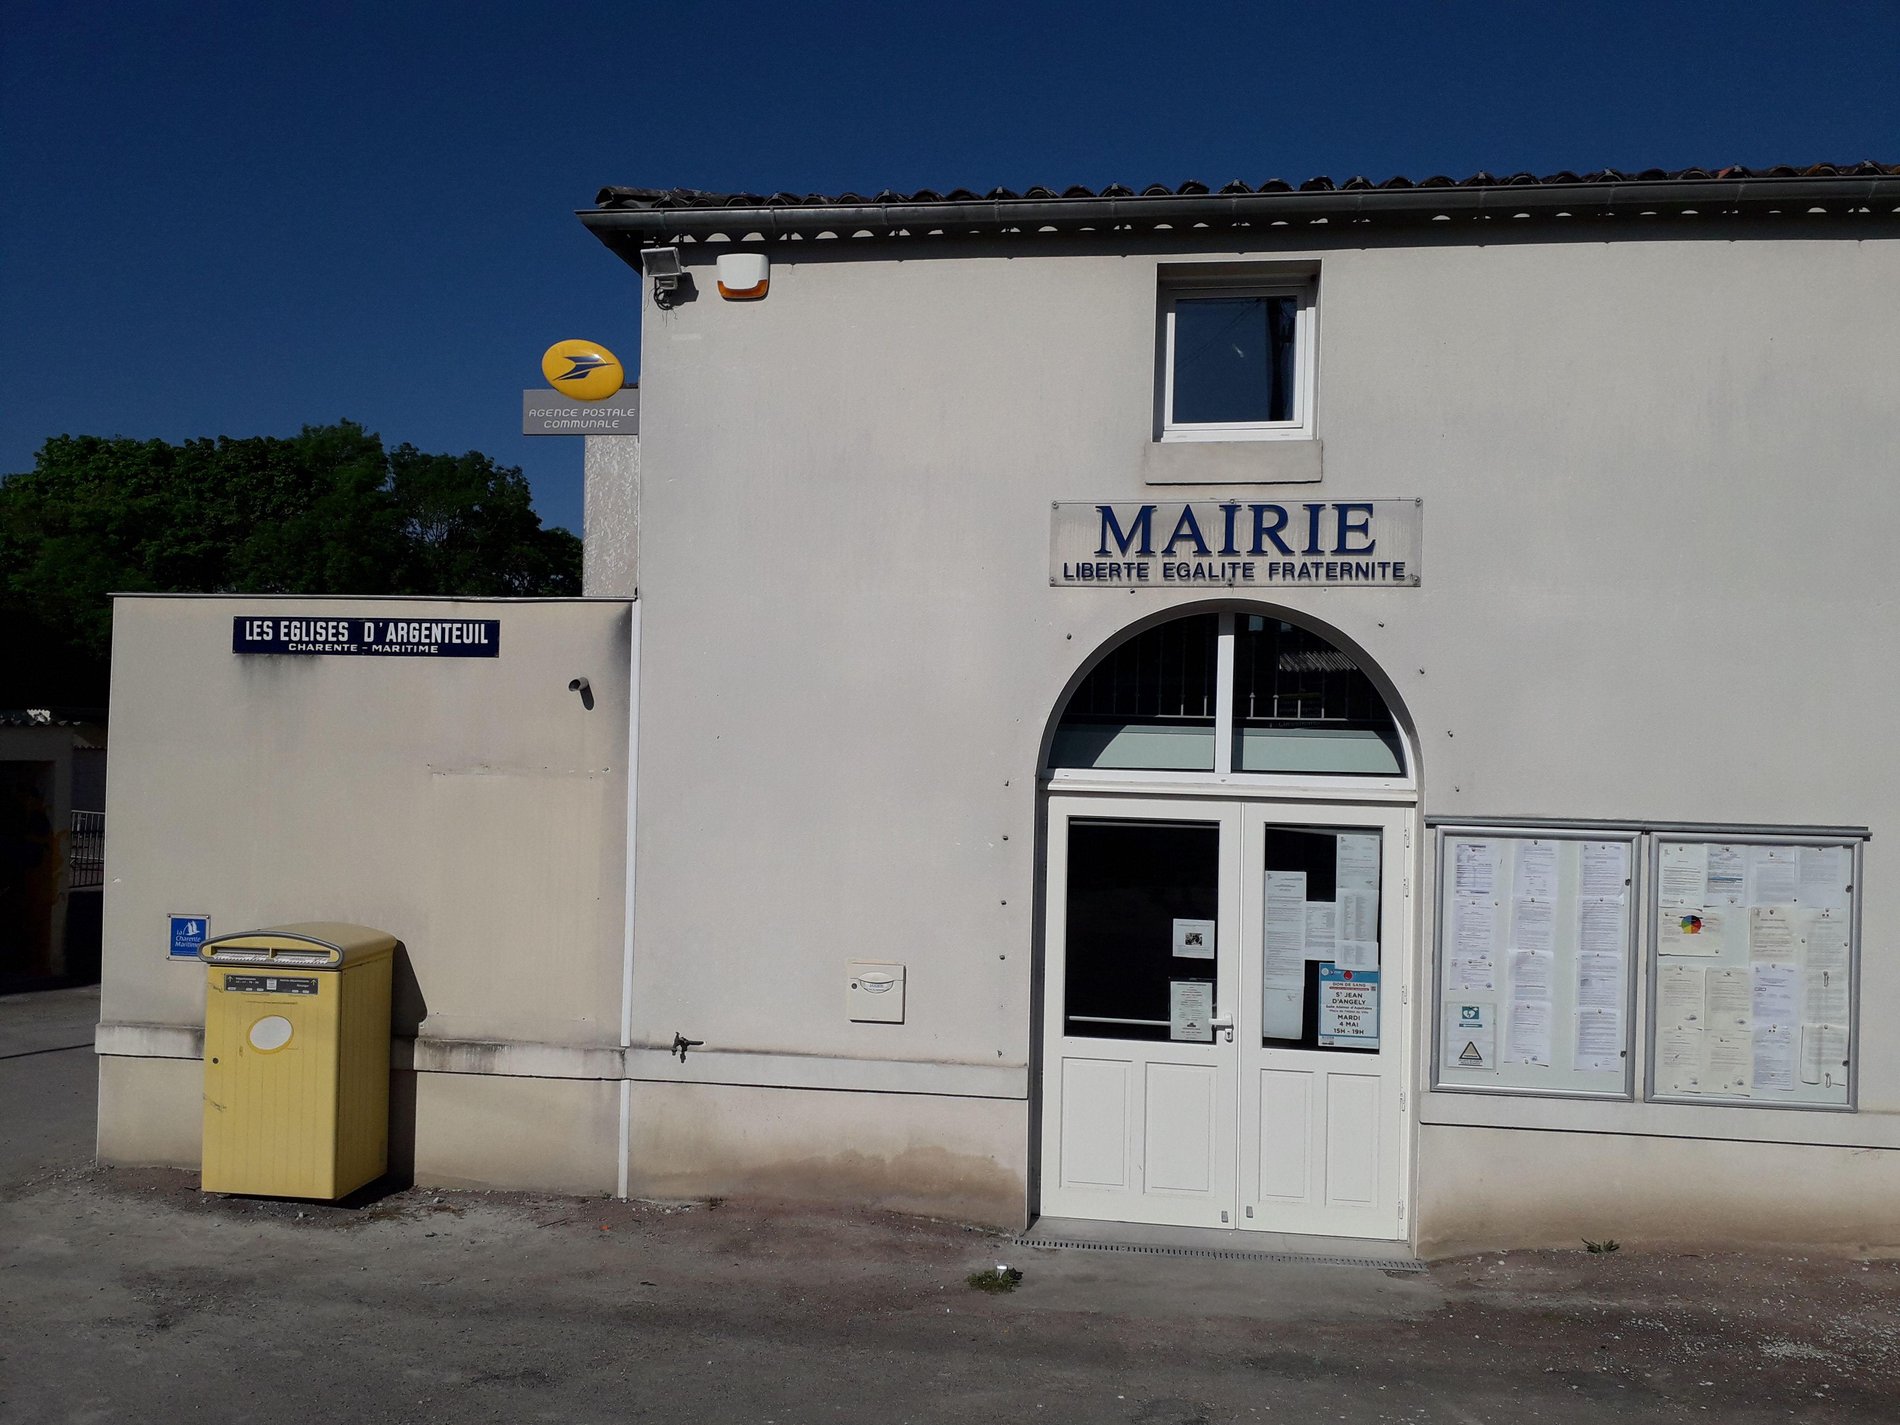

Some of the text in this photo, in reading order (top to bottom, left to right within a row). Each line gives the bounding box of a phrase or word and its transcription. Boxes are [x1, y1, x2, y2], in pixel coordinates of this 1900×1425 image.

[528, 408, 636, 417] AGENCE POSTALE
[543, 419, 620, 429] COMMUNALE
[1093, 502, 1377, 557] MAIRIE
[1063, 561, 1406, 580] LIBERTE EGALITE FRATERNITE
[245, 620, 273, 641] LES
[279, 620, 349, 642] EGLISES
[175, 935, 202, 943] Charente
